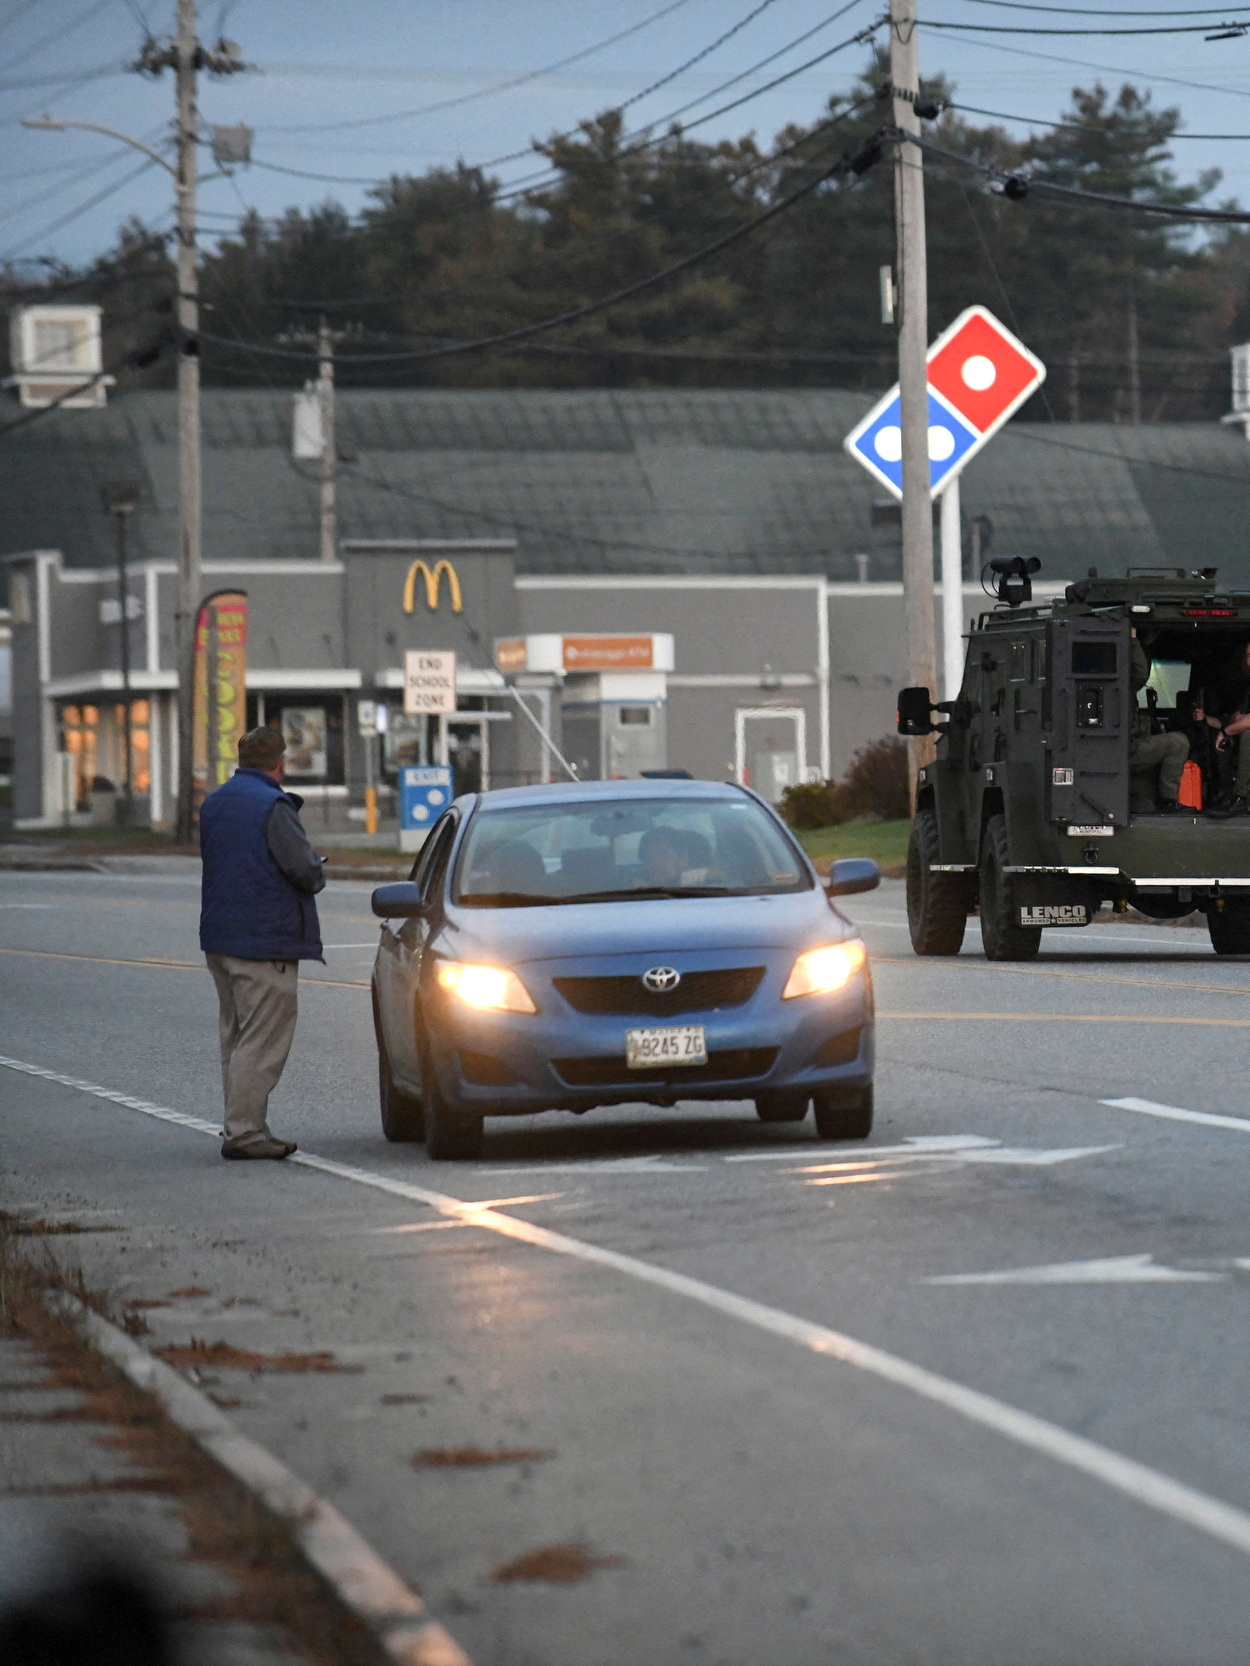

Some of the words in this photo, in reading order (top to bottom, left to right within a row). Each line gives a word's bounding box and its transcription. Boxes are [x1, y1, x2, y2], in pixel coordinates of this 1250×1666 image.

[418, 658, 442, 671] END
[409, 676, 449, 689] SCHOOL
[415, 693, 445, 706] ZONE
[1021, 905, 1086, 918] LENCO
